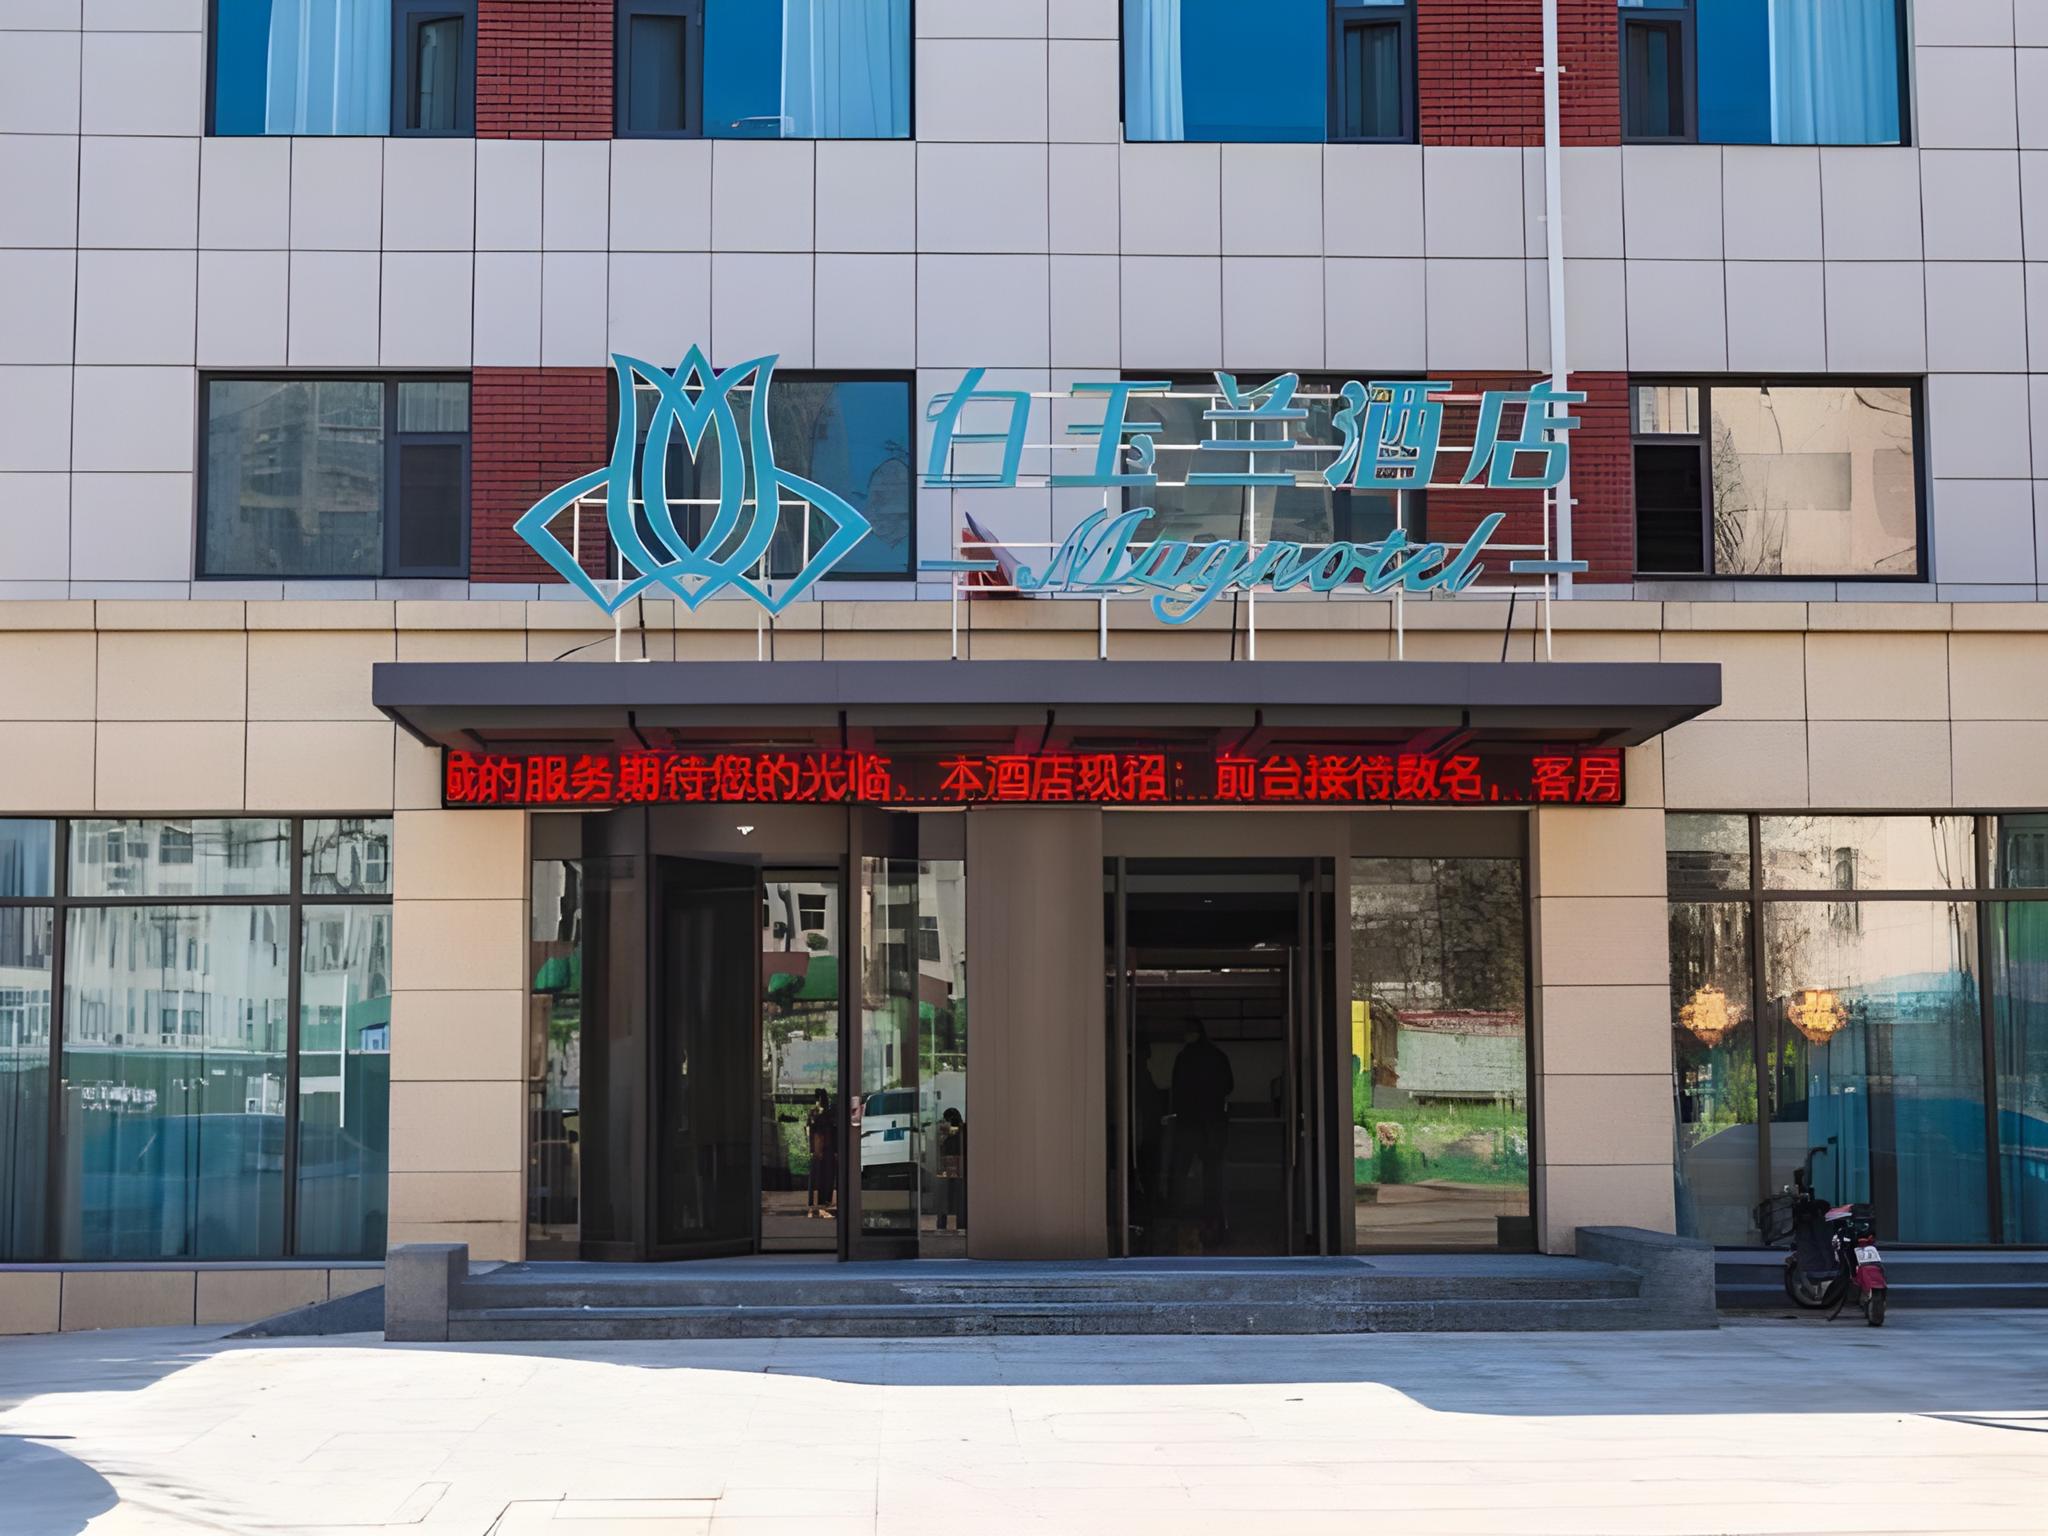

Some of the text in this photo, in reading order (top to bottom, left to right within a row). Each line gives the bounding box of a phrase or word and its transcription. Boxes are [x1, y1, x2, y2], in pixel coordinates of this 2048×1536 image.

[921, 368, 1587, 489] 白玉兰酒店
